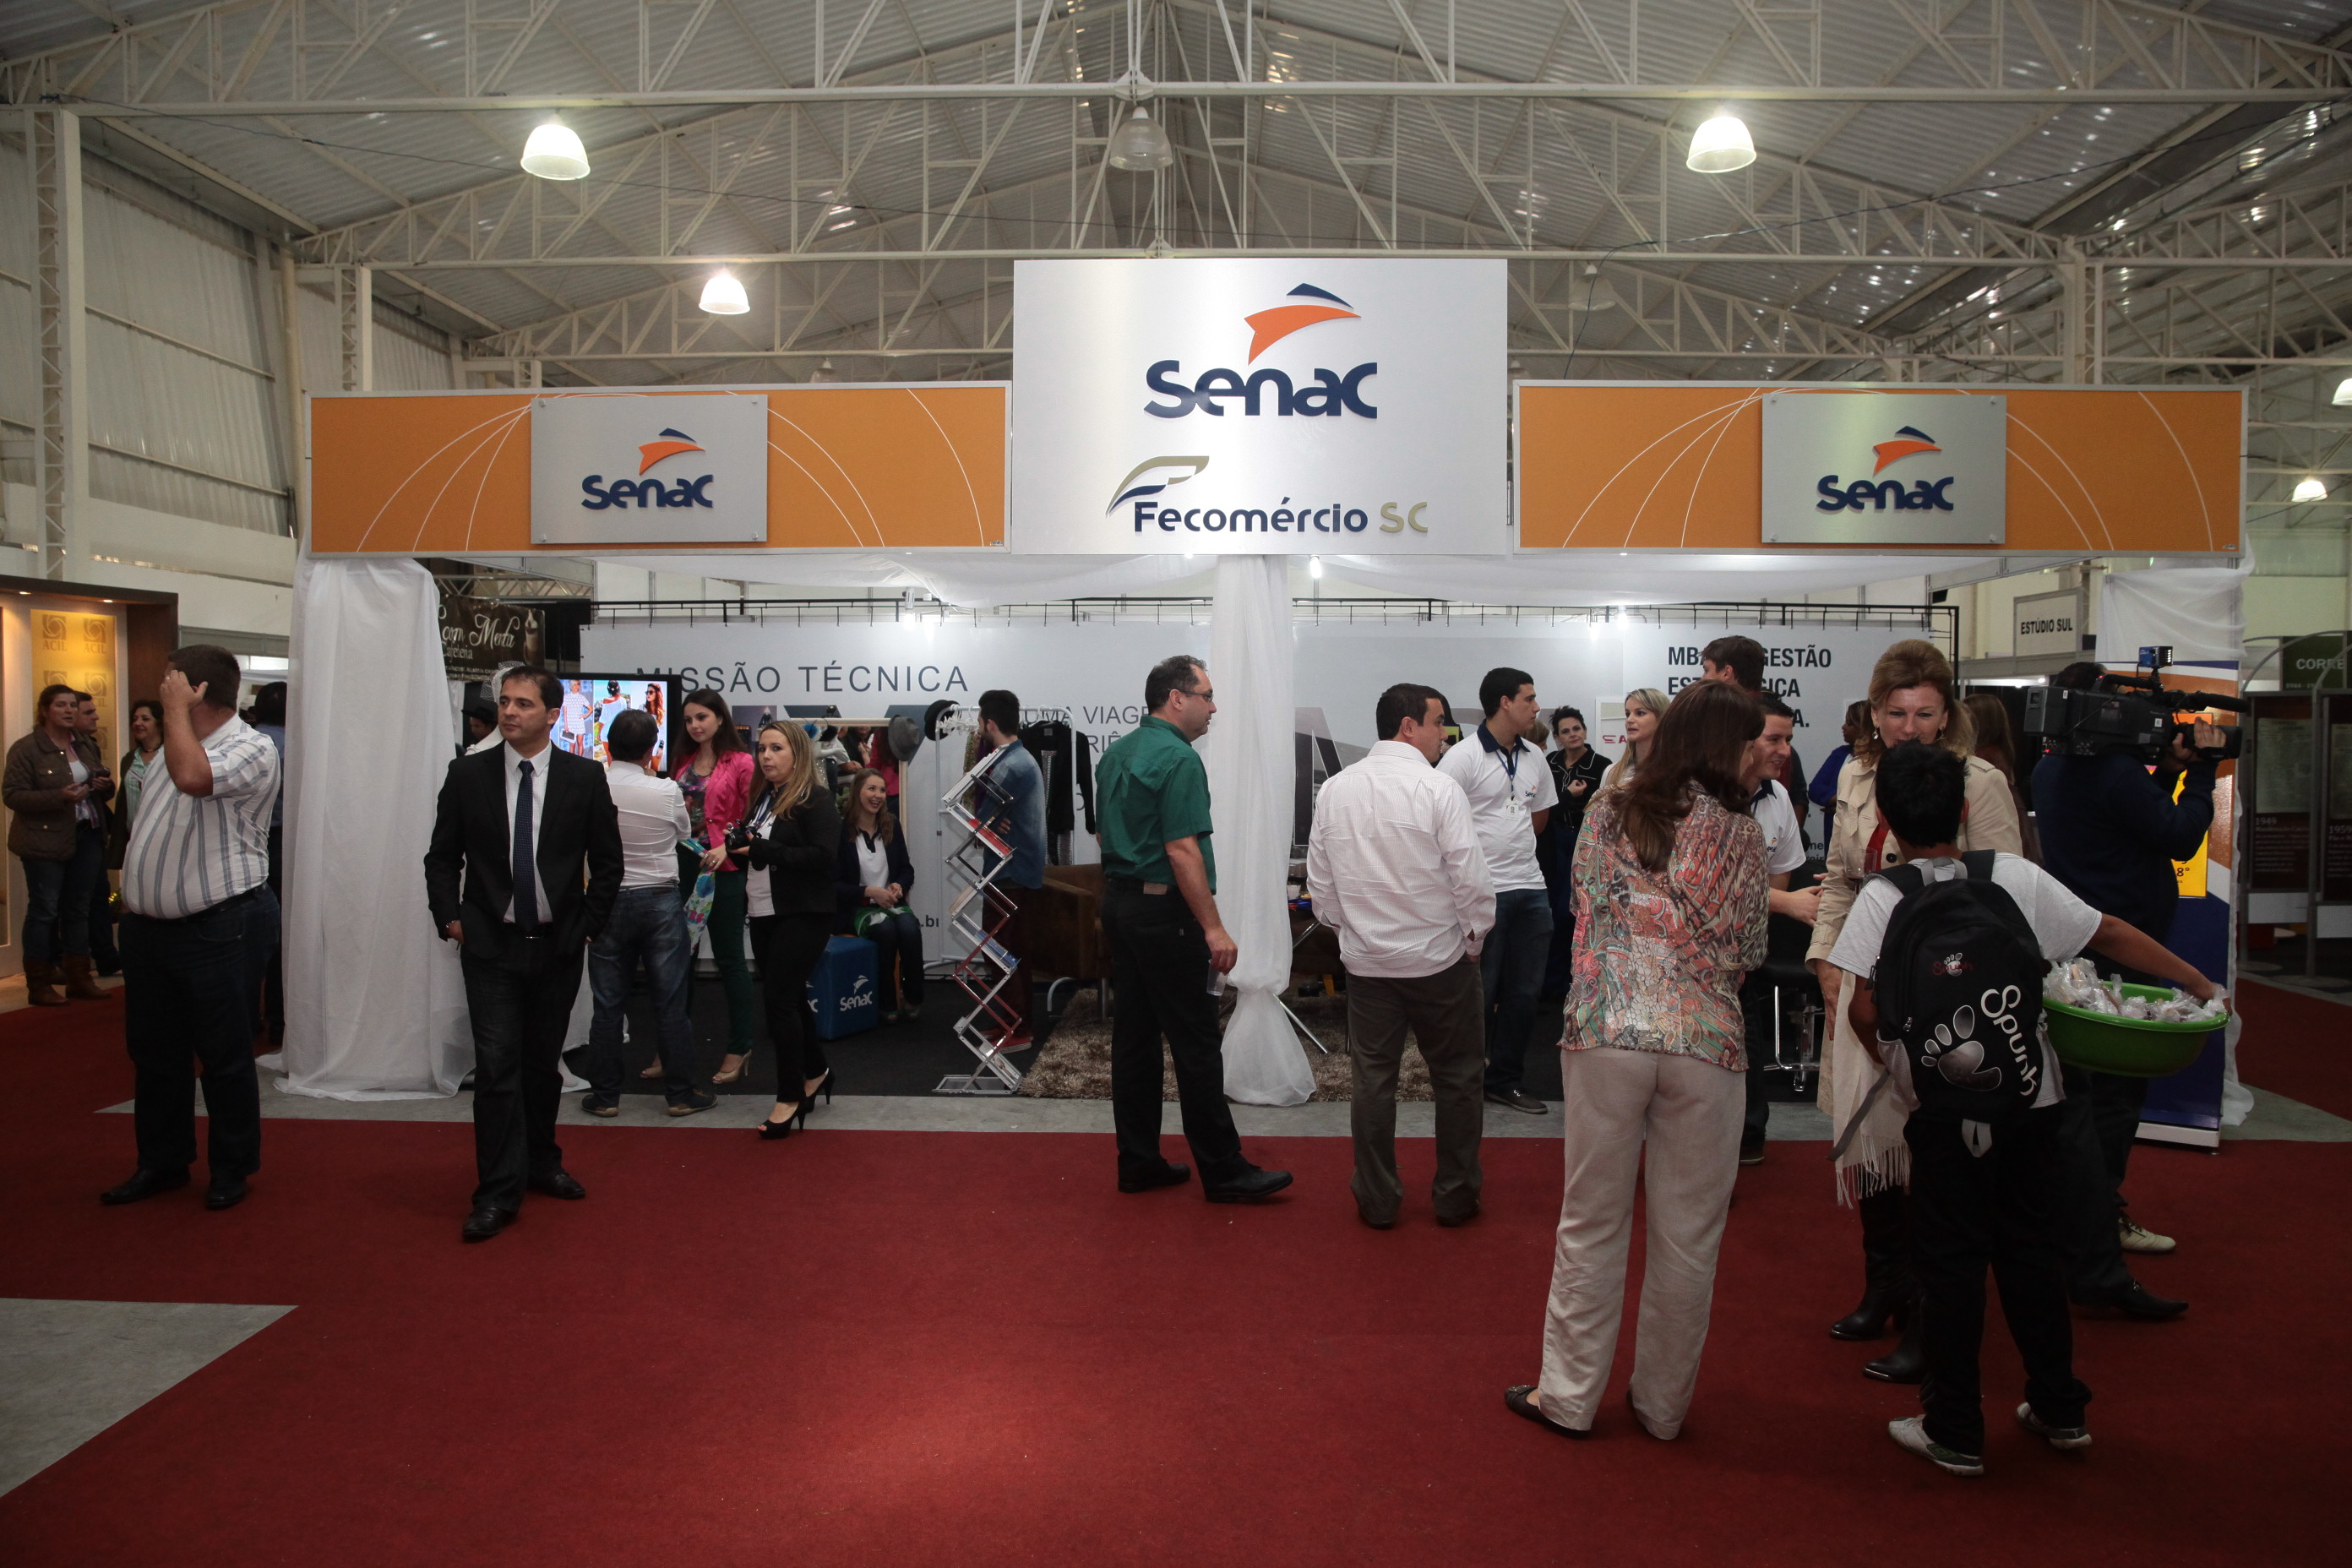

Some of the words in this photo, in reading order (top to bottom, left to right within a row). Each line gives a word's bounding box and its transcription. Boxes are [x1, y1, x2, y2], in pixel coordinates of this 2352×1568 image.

[1144, 360, 1377, 419] Senac
[581, 475, 713, 509] Senac
[1816, 475, 1953, 510] Senac
[1135, 497, 1368, 533] Fecomércio
[1379, 502, 1428, 533] SC
[2020, 618, 2054, 634] ESTÚDIO
[2056, 618, 2073, 632] SUL
[43, 640, 67, 651] ACIL
[84, 643, 107, 654] ACIL
[798, 661, 969, 693] TÉCNICA
[840, 992, 873, 1012] Senac
